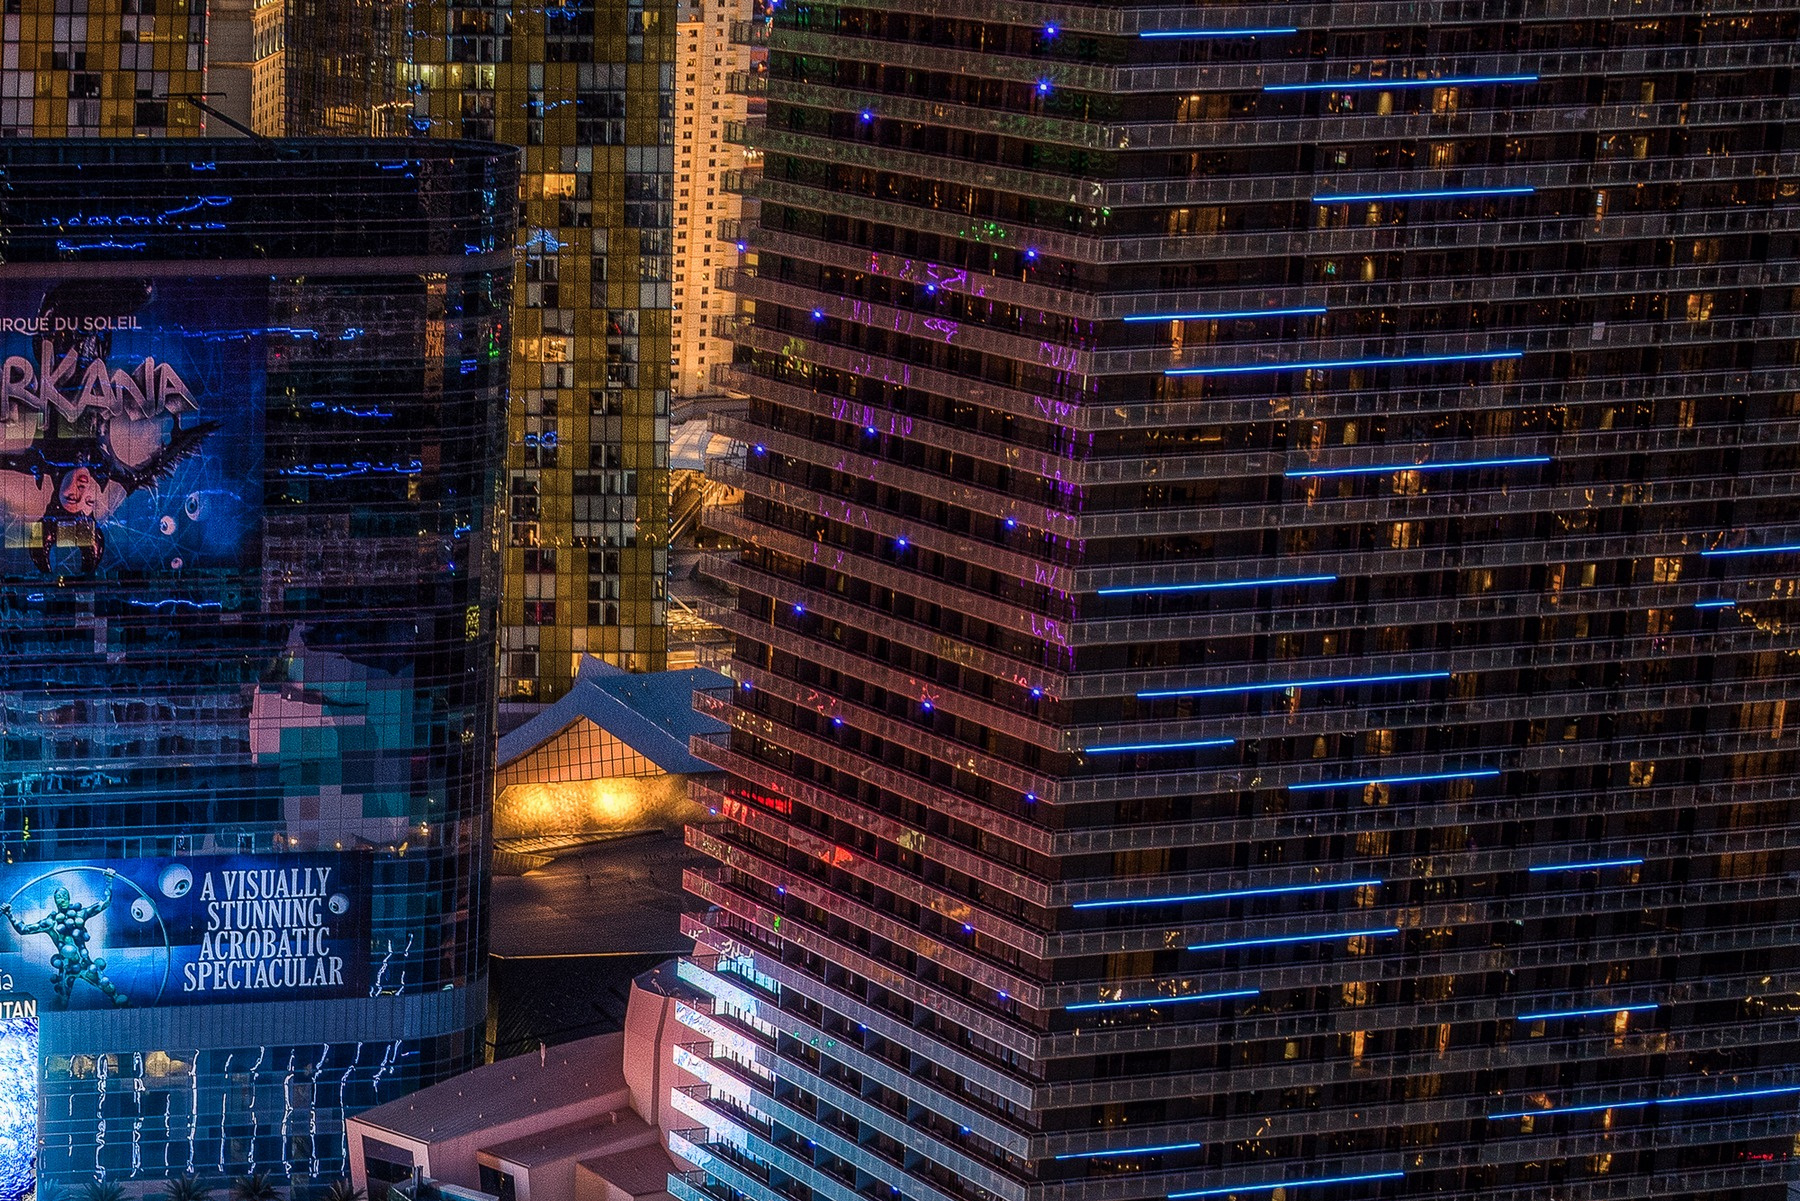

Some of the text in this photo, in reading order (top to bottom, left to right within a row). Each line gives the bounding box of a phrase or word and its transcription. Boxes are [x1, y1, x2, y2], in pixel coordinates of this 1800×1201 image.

[53, 317, 78, 331] DU
[83, 315, 142, 331] SOLEIL
[201, 867, 332, 900] A VISUALLY
[207, 899, 323, 929] STUNNING
[199, 928, 331, 959] ACROBATIC
[183, 957, 344, 992] SPECTACULAR
